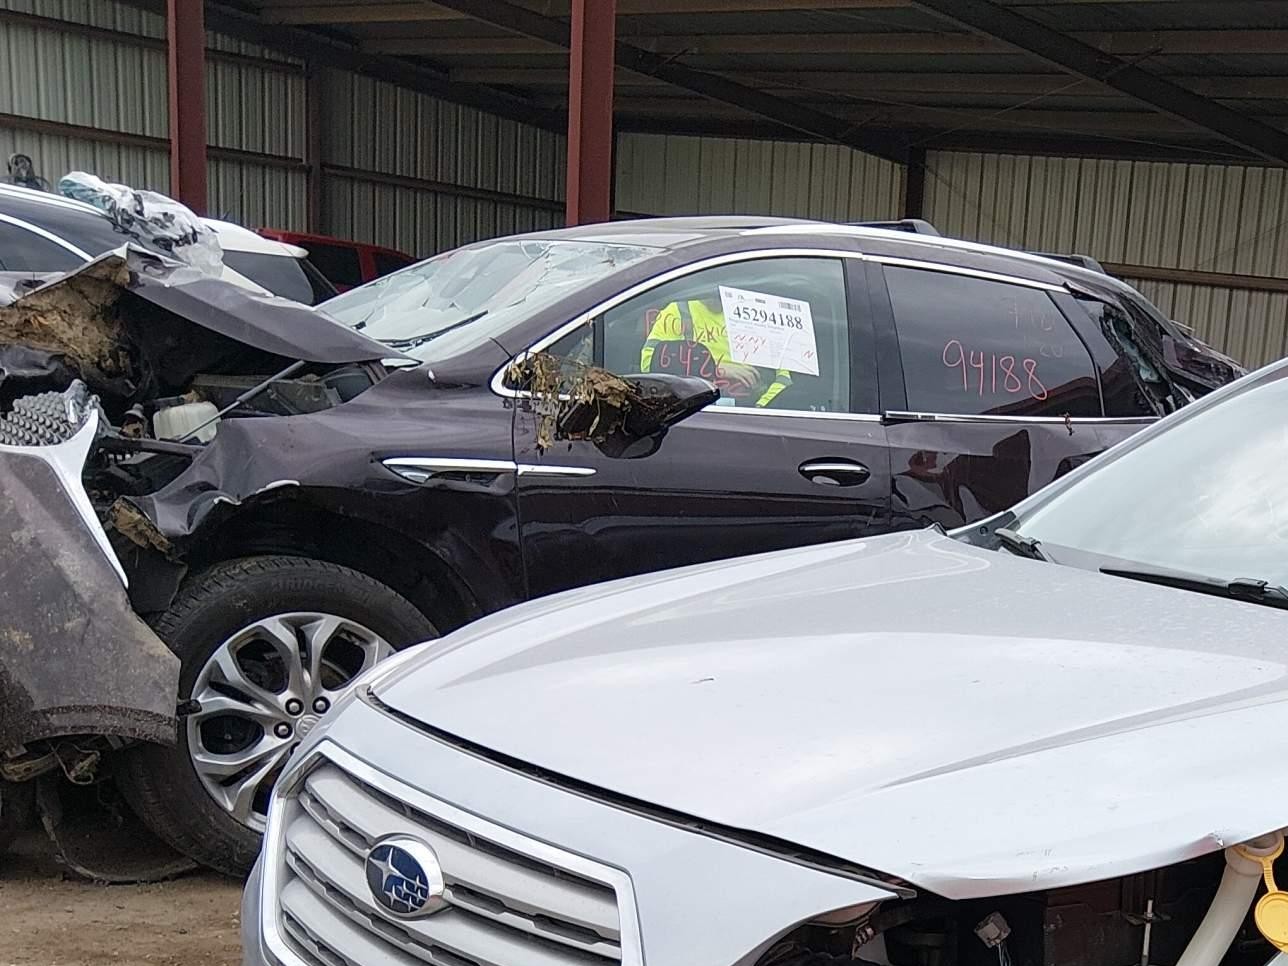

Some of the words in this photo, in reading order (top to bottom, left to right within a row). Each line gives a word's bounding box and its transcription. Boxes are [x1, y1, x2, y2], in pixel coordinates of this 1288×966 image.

[732, 305, 804, 330] 45294188
[660, 343, 726, 378] 6-4-26
[942, 339, 1048, 400] 94188
